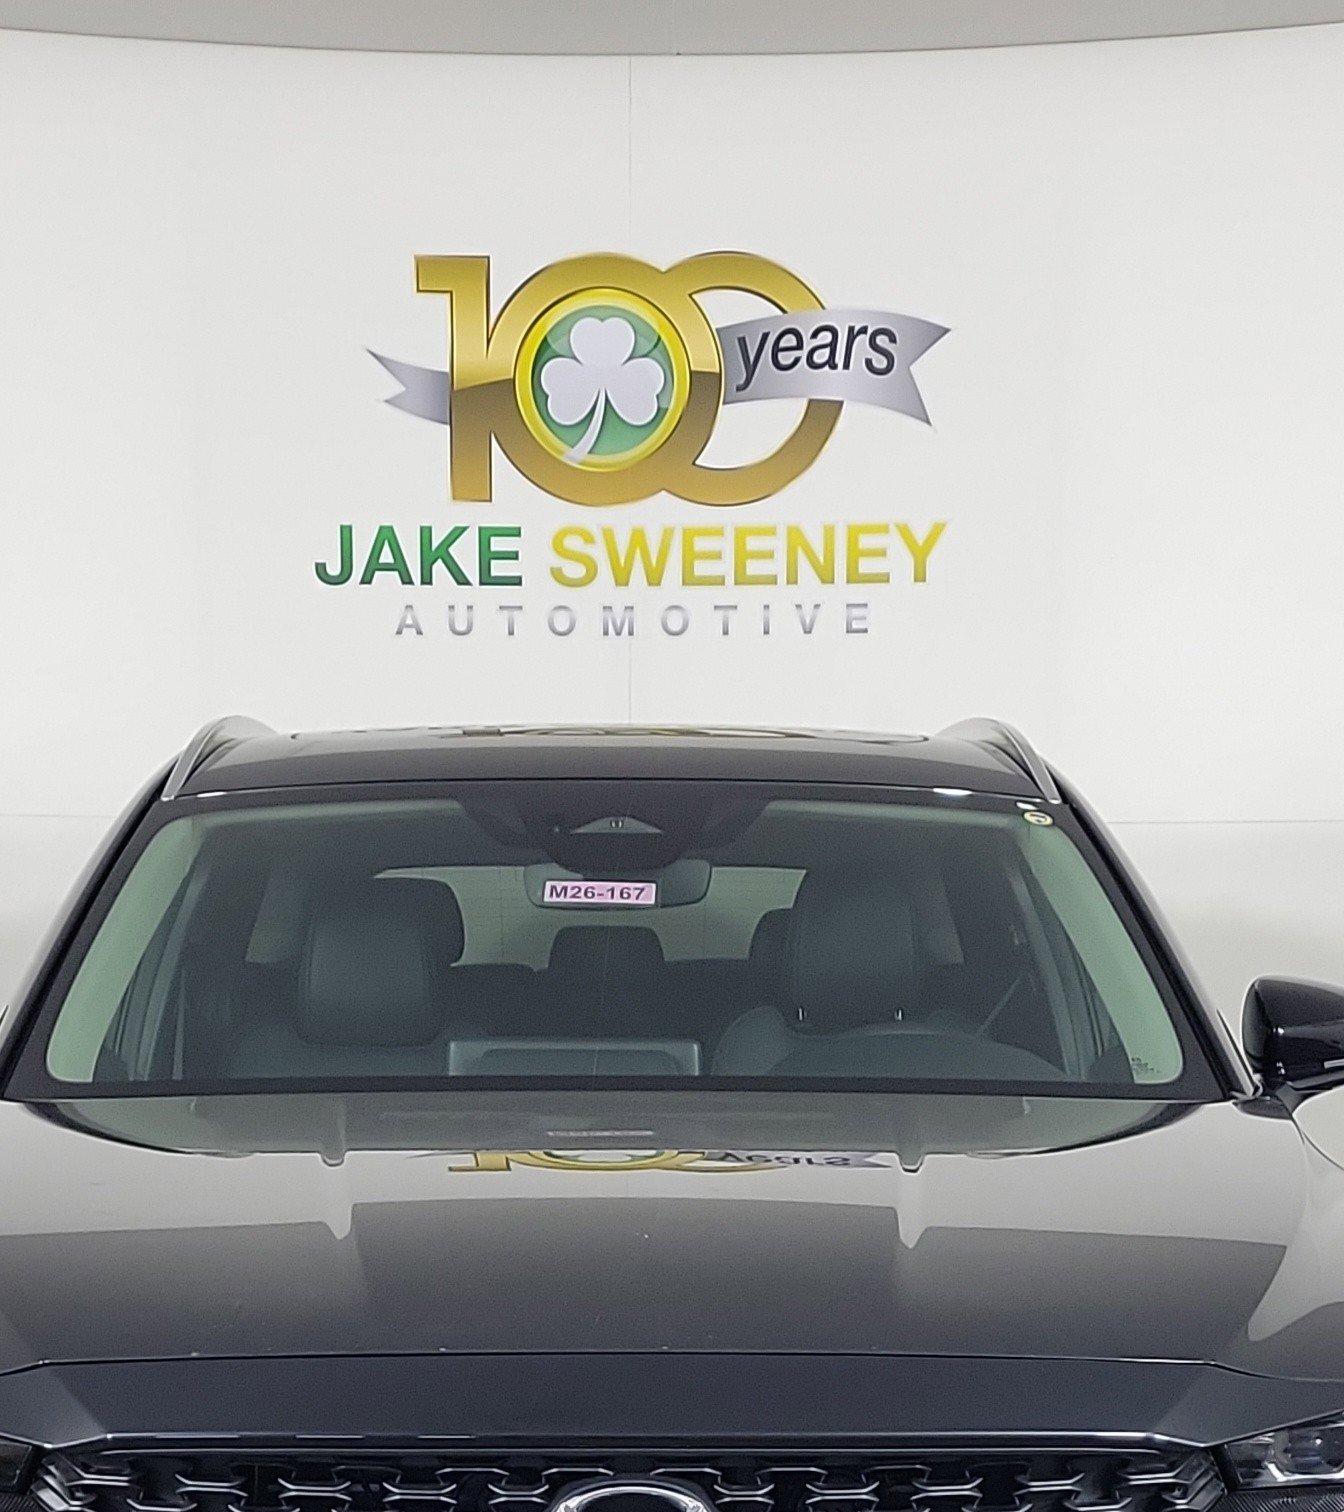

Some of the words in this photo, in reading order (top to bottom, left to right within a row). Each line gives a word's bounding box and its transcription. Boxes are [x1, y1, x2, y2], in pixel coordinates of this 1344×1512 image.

[736, 323, 899, 393] years
[314, 525, 523, 587] JAKE
[549, 522, 948, 588] SWEENEY
[395, 603, 871, 637] AUTOMOTIVE
[549, 884, 646, 900] M26-167
